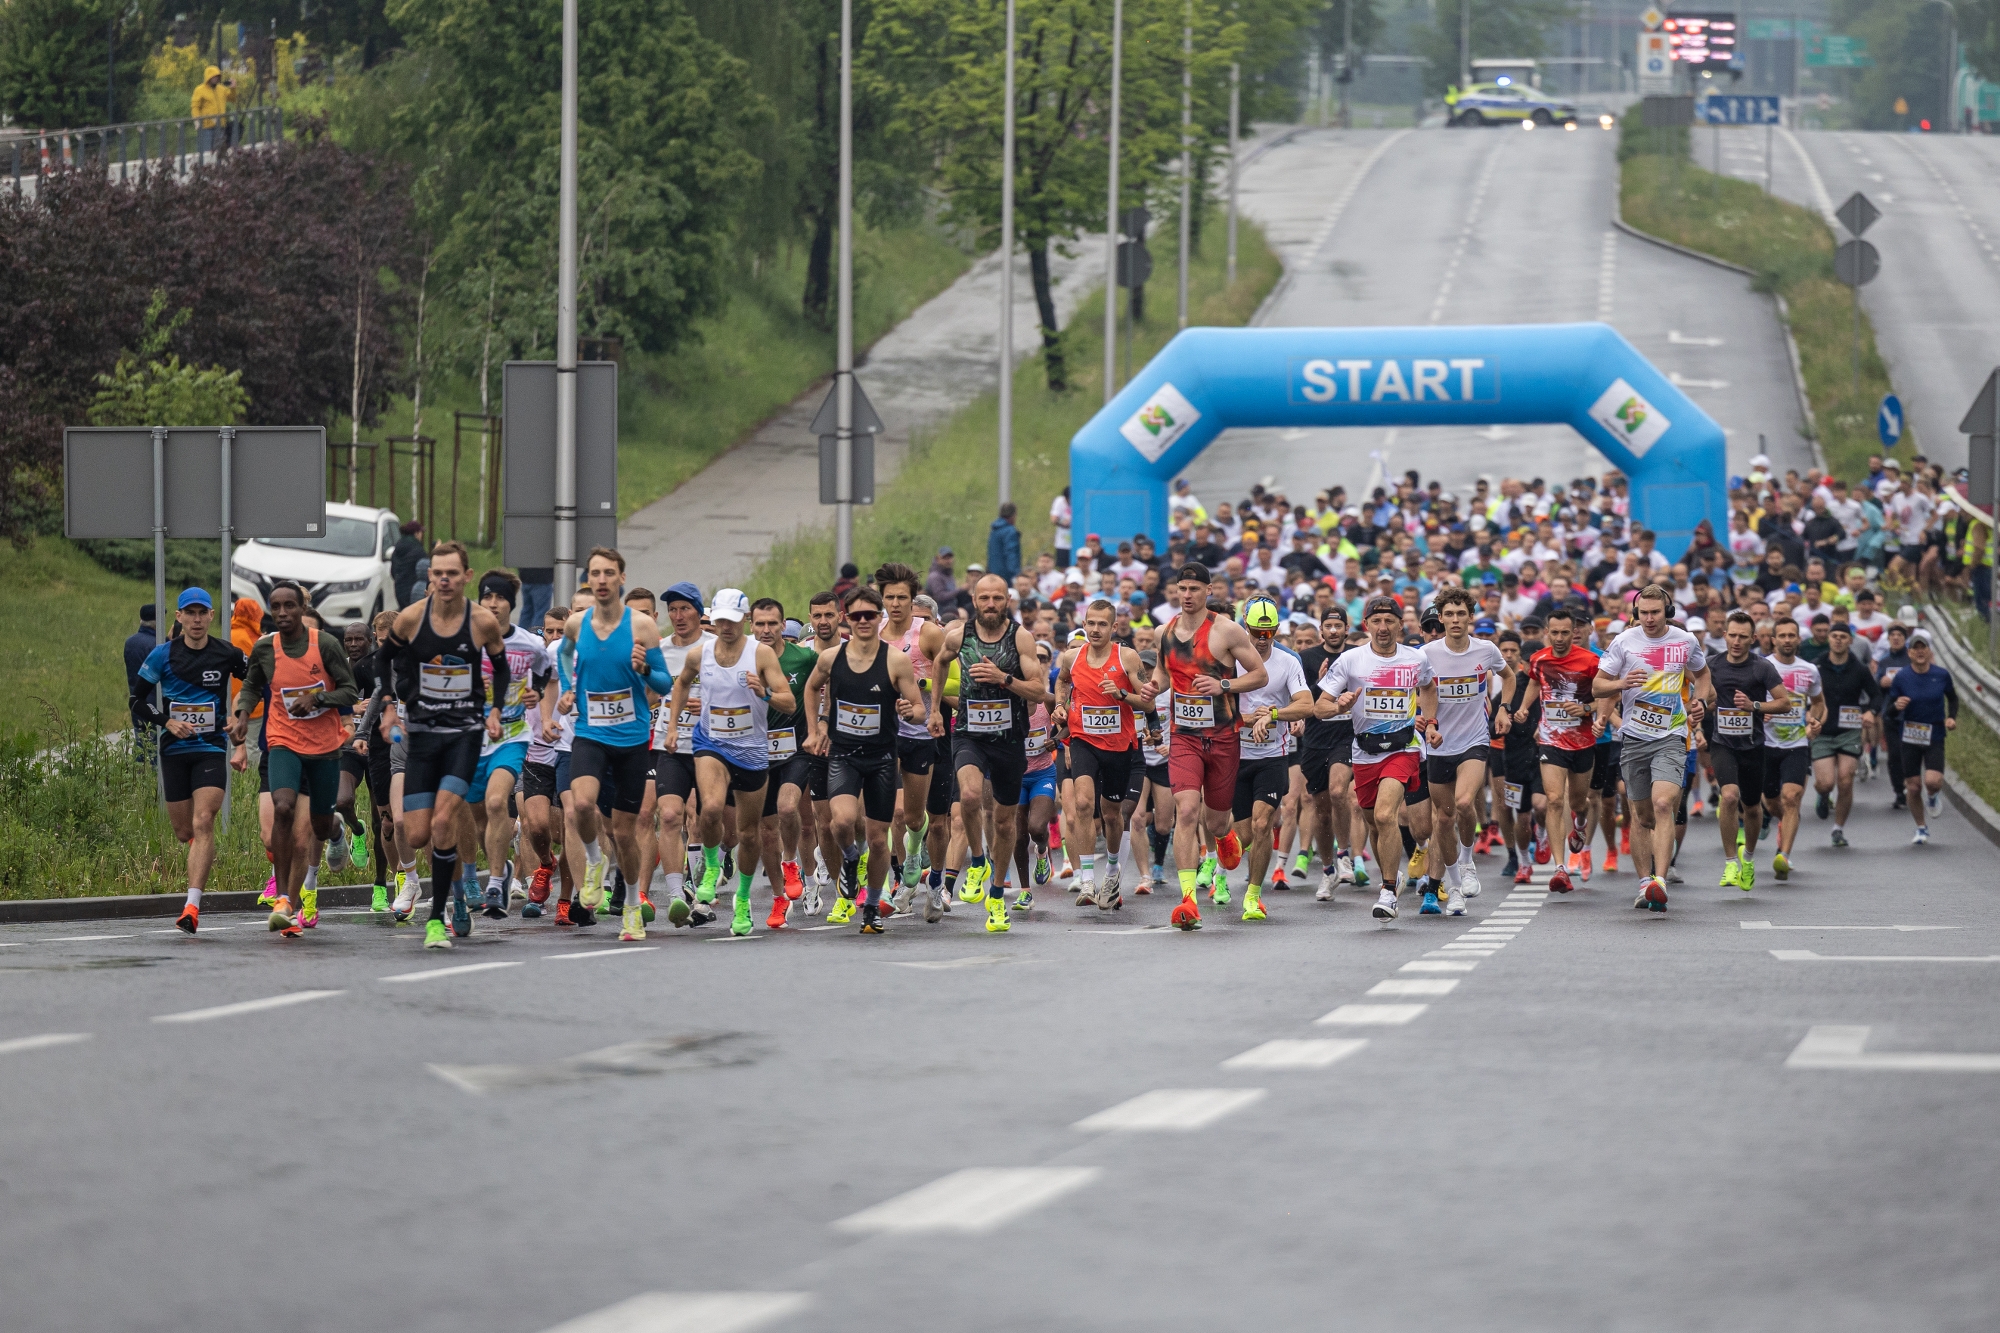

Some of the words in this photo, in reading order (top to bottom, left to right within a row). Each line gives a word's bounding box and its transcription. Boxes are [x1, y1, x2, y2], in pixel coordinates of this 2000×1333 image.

[1301, 359, 1485, 402] START
[1665, 646, 1685, 663] FIAT
[443, 677, 452, 688] 7
[1450, 684, 1469, 695] 181
[600, 702, 624, 715] 156
[1372, 698, 1404, 710] 1514
[978, 710, 1003, 722] 912
[1182, 705, 1204, 718] 889
[1640, 710, 1663, 725] 853
[181, 713, 206, 724] 236
[727, 717, 736, 729] 8
[851, 714, 867, 727] 67
[1088, 715, 1116, 726] 1204
[1723, 716, 1749, 727] 1482
[772, 740, 779, 751] 9
[1028, 738, 1035, 748] 6
